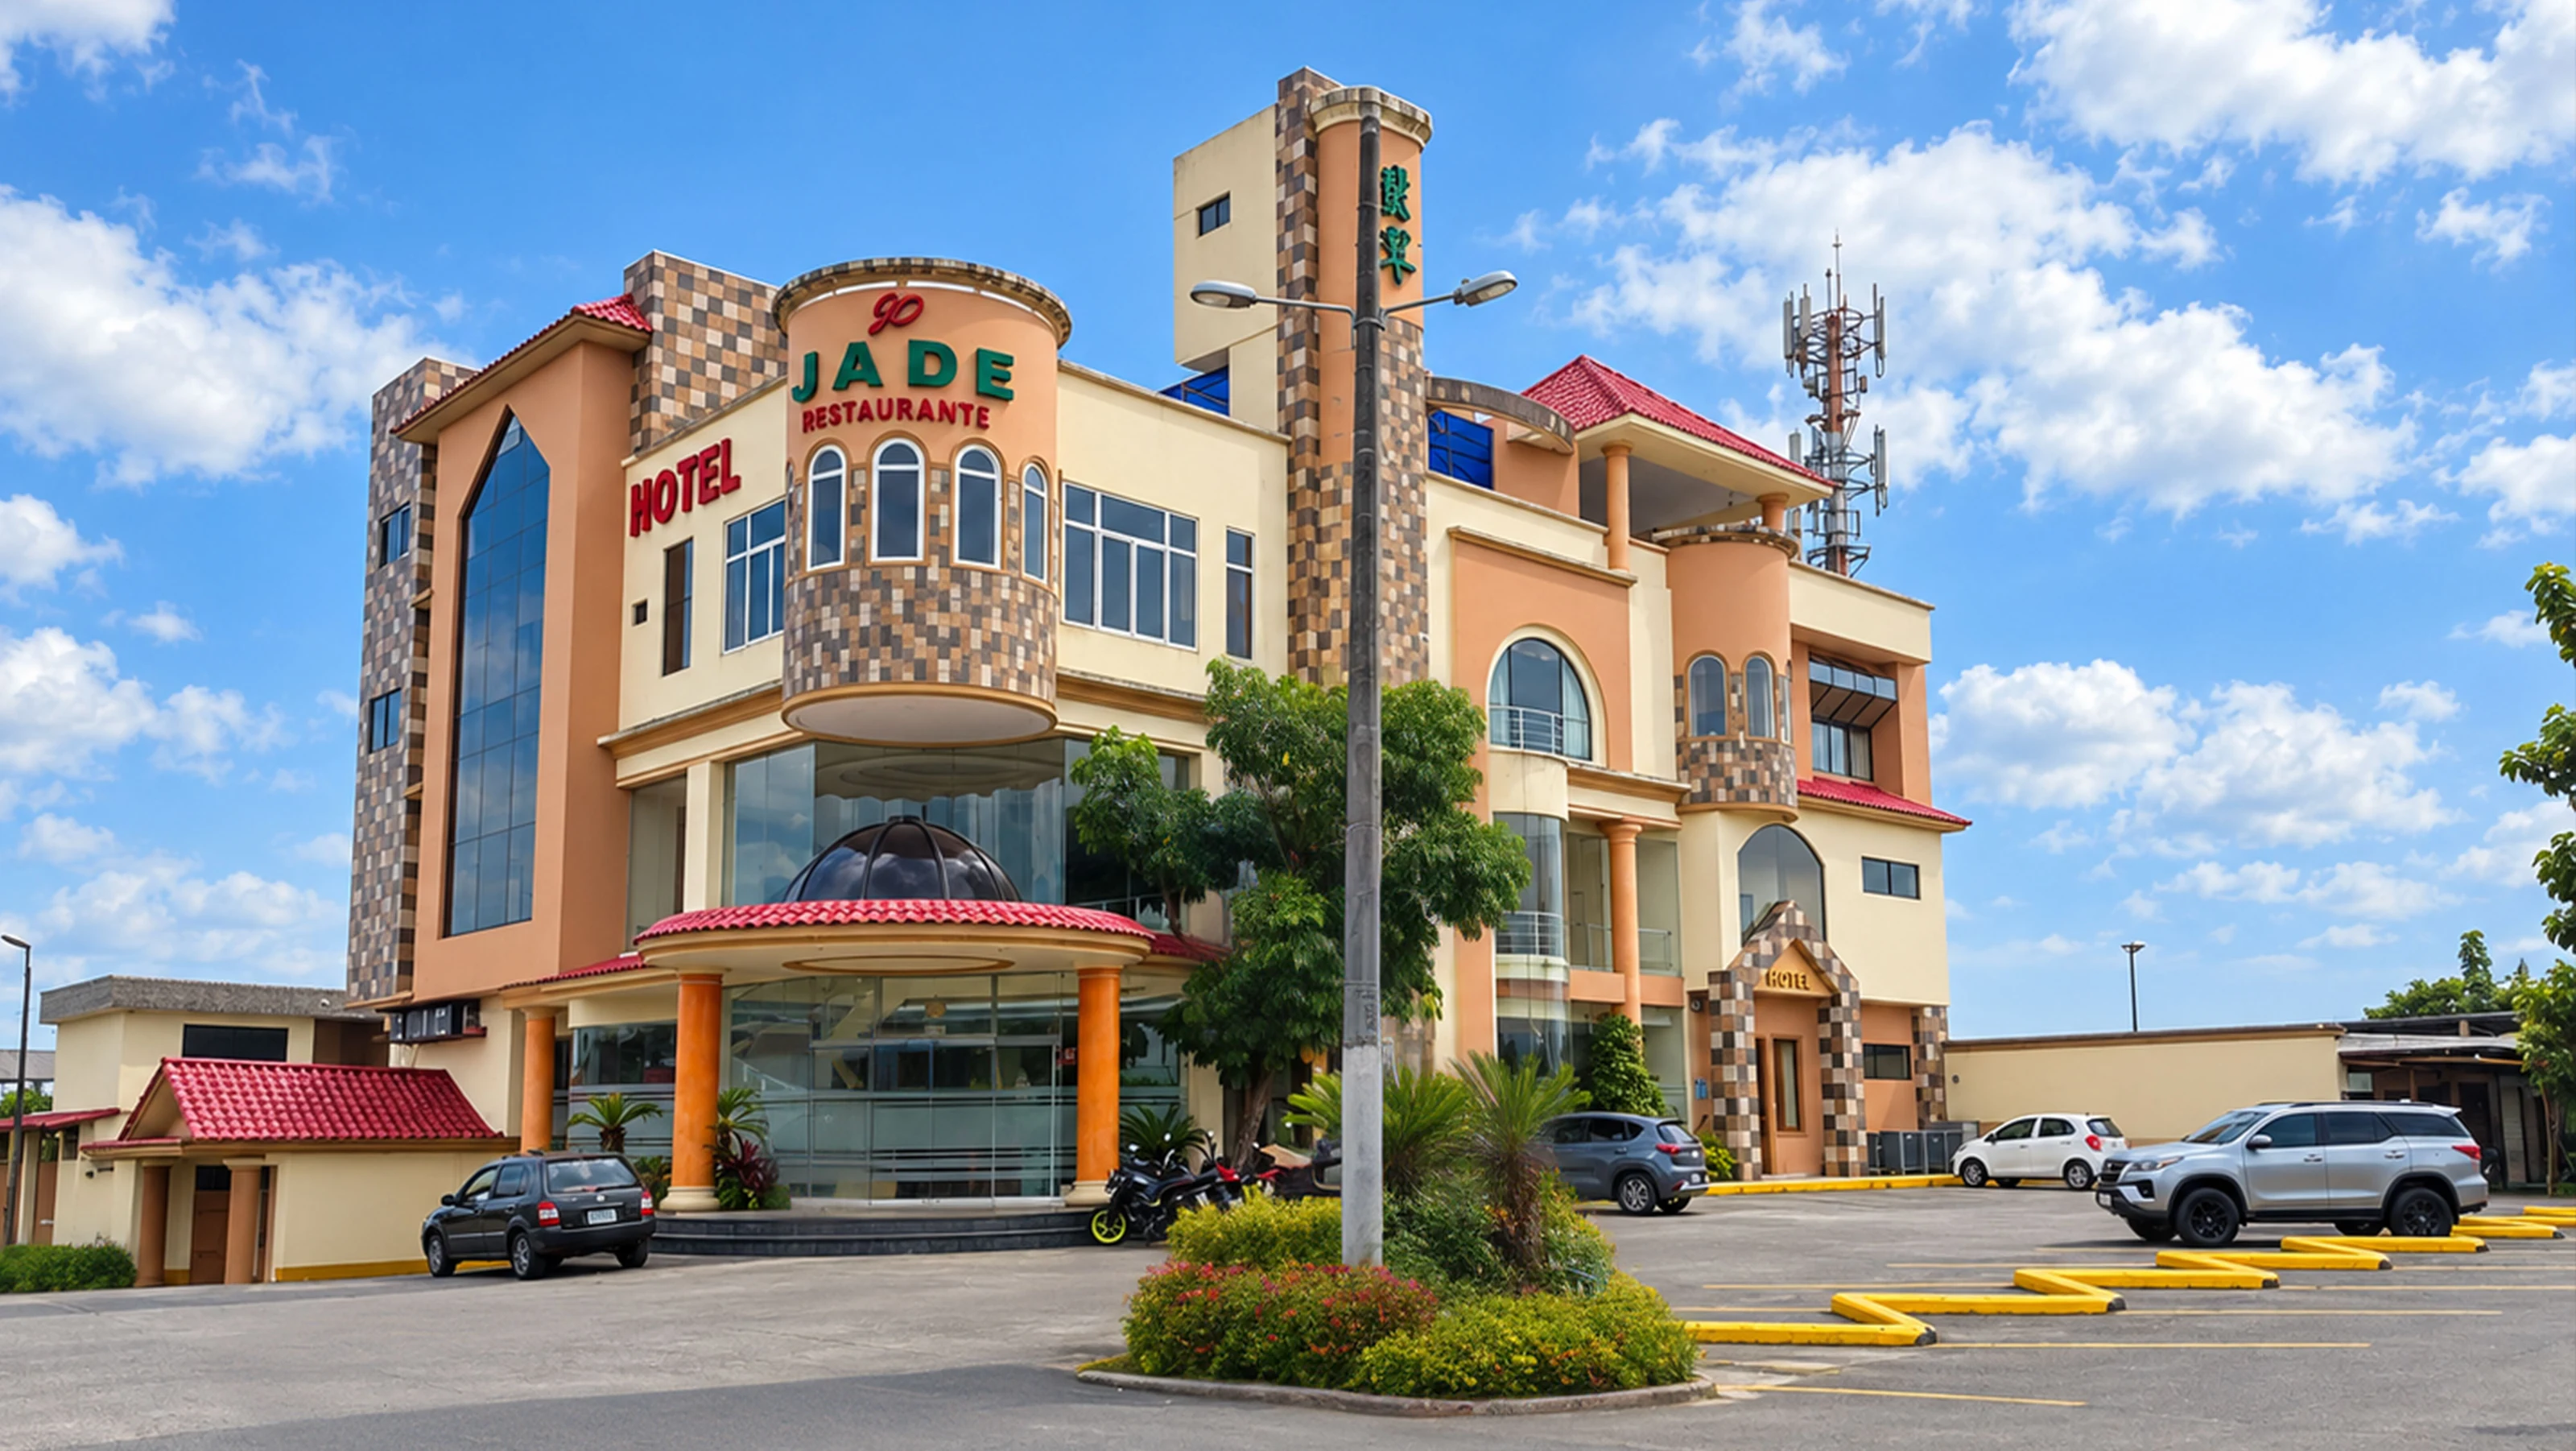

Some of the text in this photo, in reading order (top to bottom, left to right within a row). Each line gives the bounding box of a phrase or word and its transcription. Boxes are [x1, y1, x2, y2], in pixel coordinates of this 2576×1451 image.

[791, 338, 1015, 403] JADE
[802, 397, 991, 434] RESTAURANTE
[629, 437, 742, 539] HOTEL
[1765, 969, 1810, 991] HOTEL
